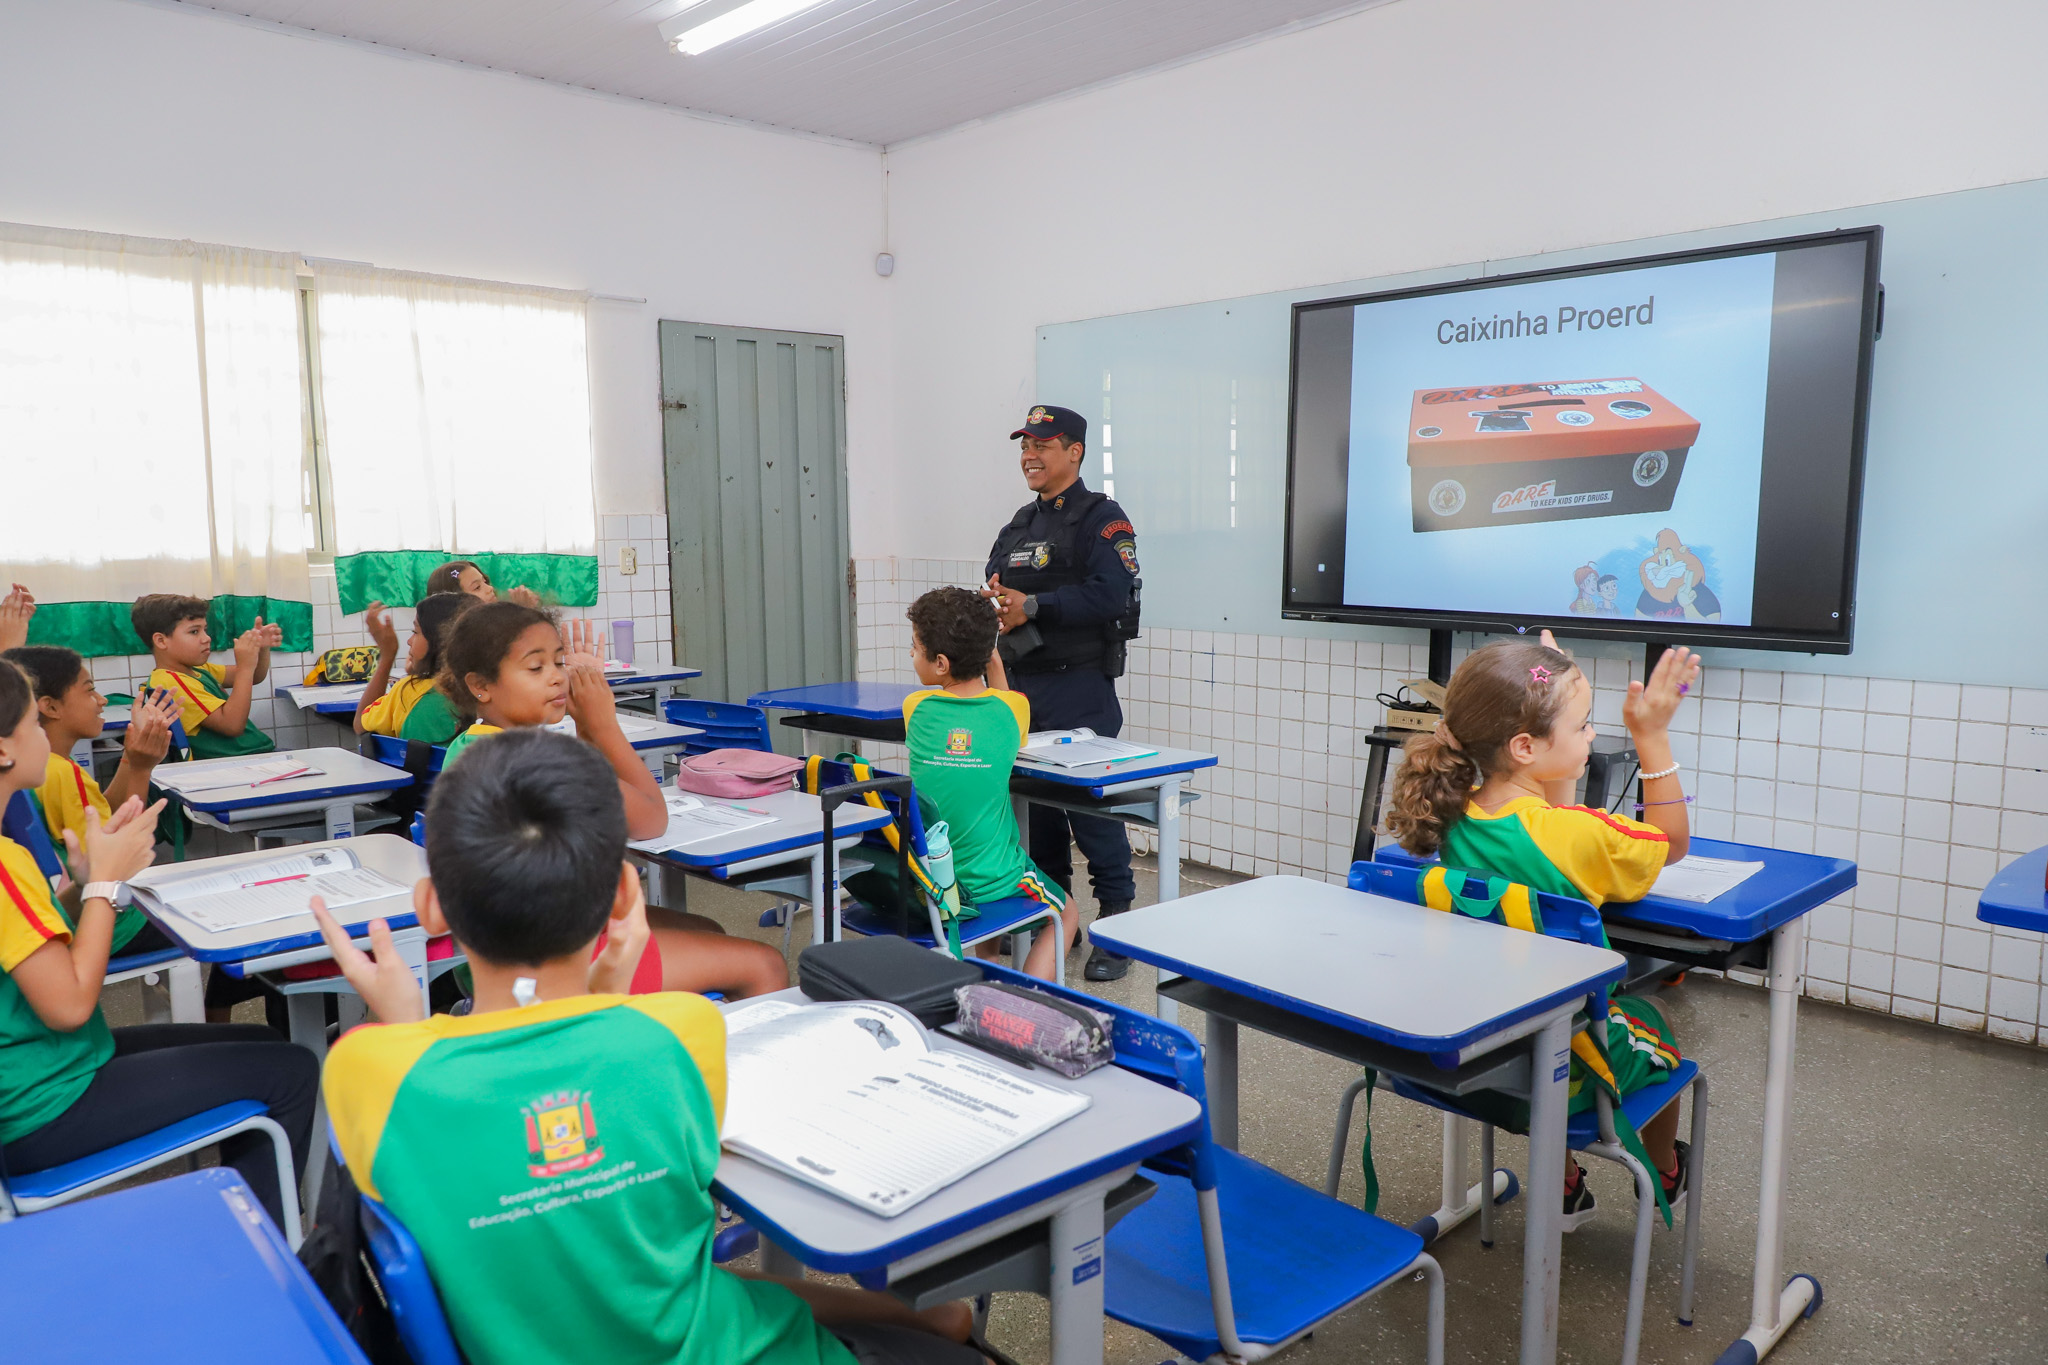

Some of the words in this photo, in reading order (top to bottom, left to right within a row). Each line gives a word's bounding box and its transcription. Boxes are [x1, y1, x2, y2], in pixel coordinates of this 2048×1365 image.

[1437, 310, 1548, 344] Caixinha
[1557, 296, 1655, 333] Proerd
[1530, 500, 1539, 508] TO
[1540, 498, 1556, 507] KEEP
[1558, 497, 1572, 505] KIDS
[1574, 495, 1586, 503] OFF
[1103, 522, 1132, 536] PROERD
[468, 1207, 533, 1229] Educação,
[534, 1194, 582, 1214] Cultura,
[628, 1176, 636, 1185] e
[637, 1167, 669, 1183] Lazer
[499, 1181, 562, 1206] Secretaria
[564, 1164, 620, 1189] Municipal
[621, 1161, 636, 1173] de
